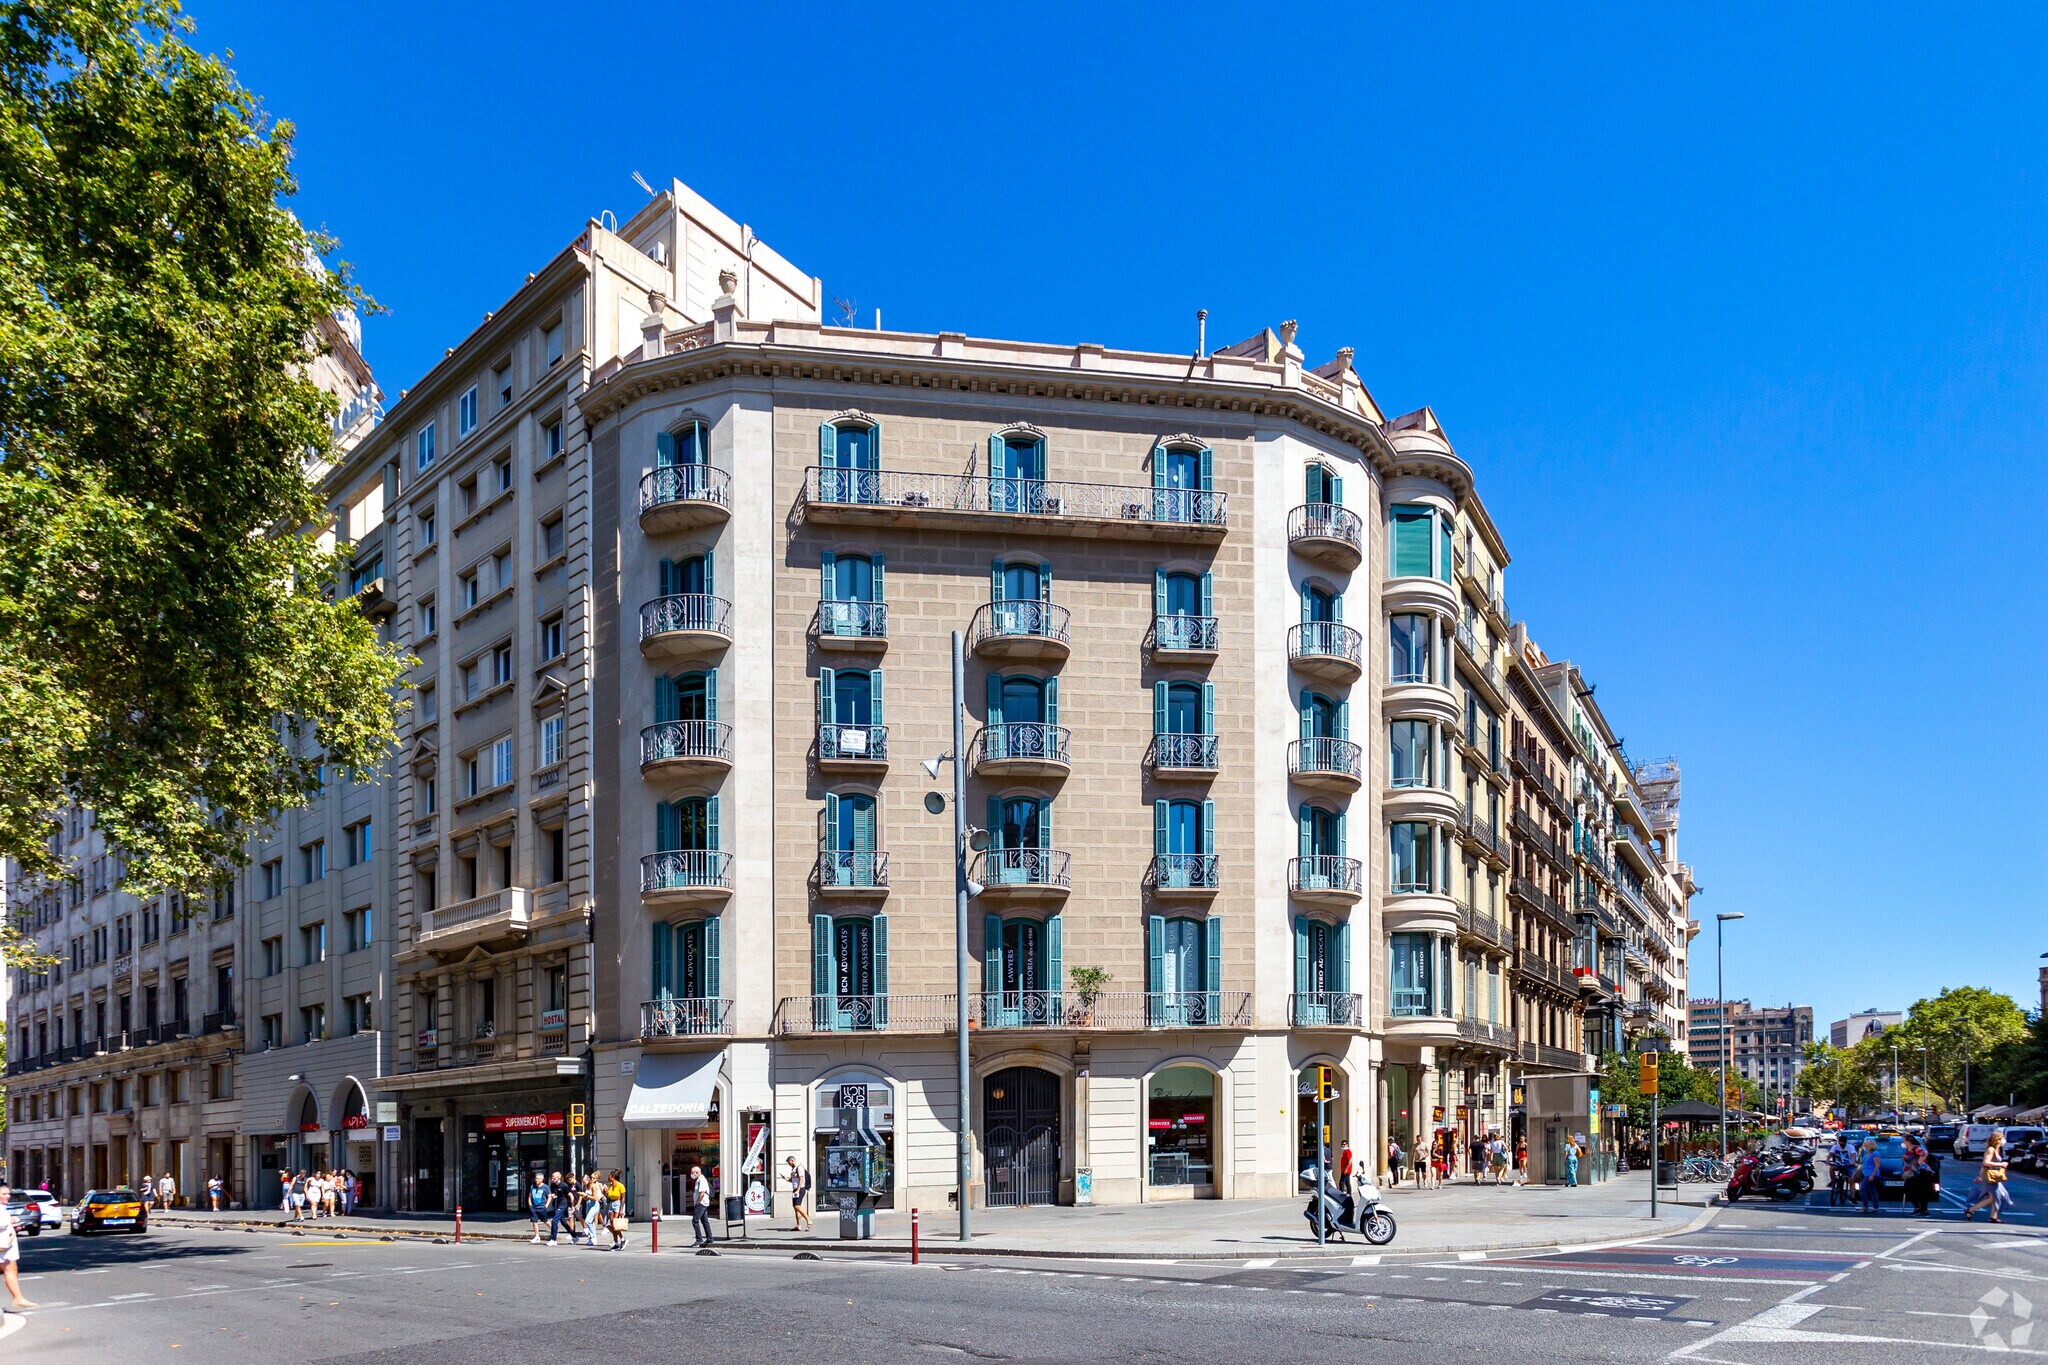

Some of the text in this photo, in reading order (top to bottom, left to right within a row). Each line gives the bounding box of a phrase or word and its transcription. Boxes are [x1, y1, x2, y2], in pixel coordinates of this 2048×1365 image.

[544, 1014, 564, 1025] HOSTAL
[629, 1102, 704, 1114] CALZEDONIA
[506, 1116, 539, 1127] SUPERMERCAT
